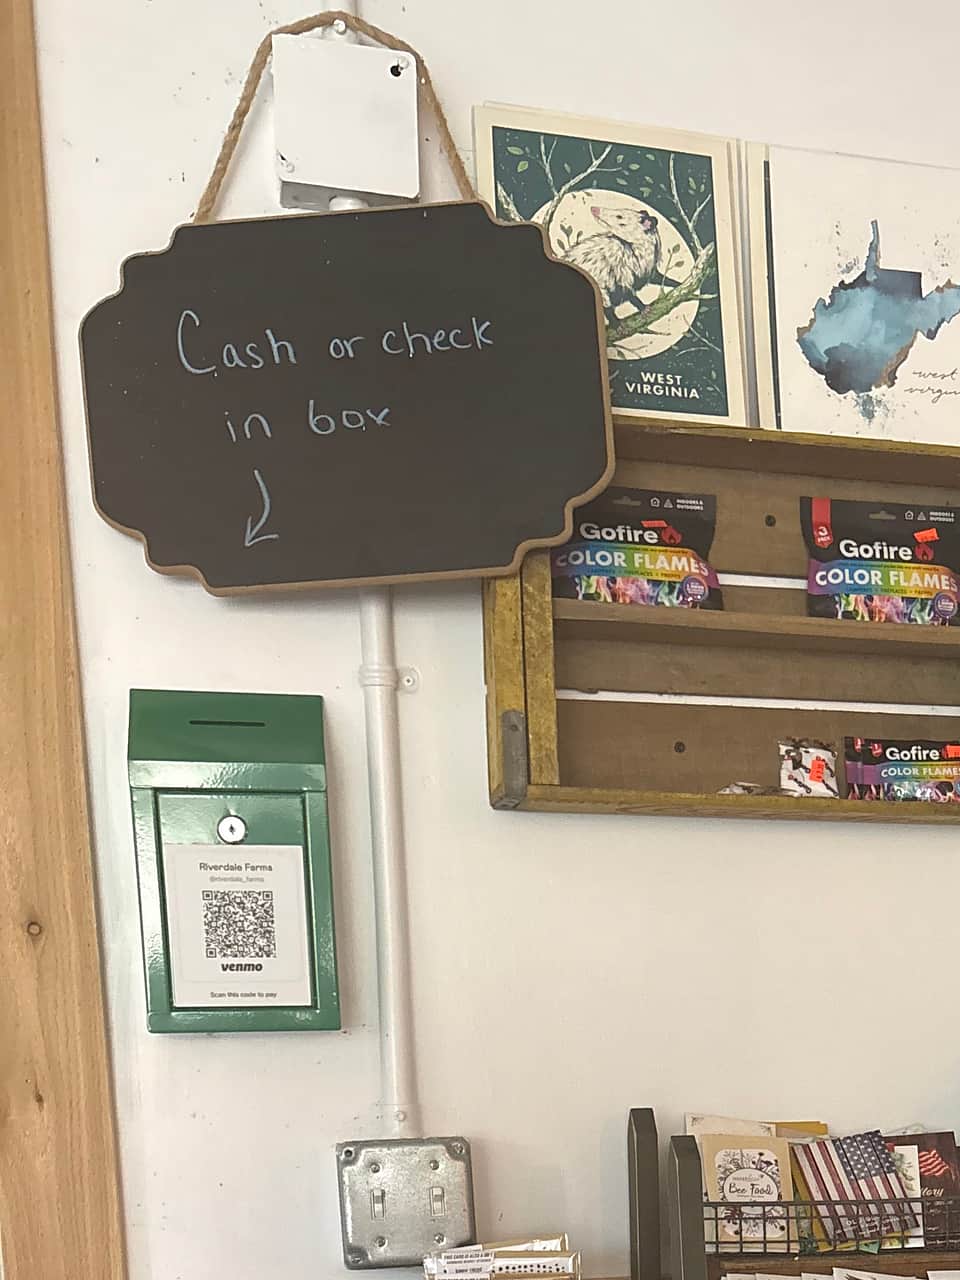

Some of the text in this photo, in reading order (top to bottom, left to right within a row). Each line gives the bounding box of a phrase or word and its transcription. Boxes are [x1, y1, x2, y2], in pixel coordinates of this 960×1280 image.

[176, 309, 494, 374] Cash or check
[640, 371, 684, 386] WEST
[911, 367, 959, 381] west
[625, 380, 700, 400] VIRGINIA
[224, 399, 393, 443] in box
[579, 523, 659, 544] Gofire
[818, 526, 829, 537] 3
[839, 539, 913, 561] Gofire
[555, 550, 709, 577] COLOR FLAMES
[815, 568, 958, 593] COLOR FLAMES
[885, 747, 940, 761] Gofire
[880, 767, 919, 778] COLOR
[199, 863, 273, 872] Riverdale Farms
[221, 963, 263, 972] venmo
[728, 1182, 774, 1196] Bee Food
